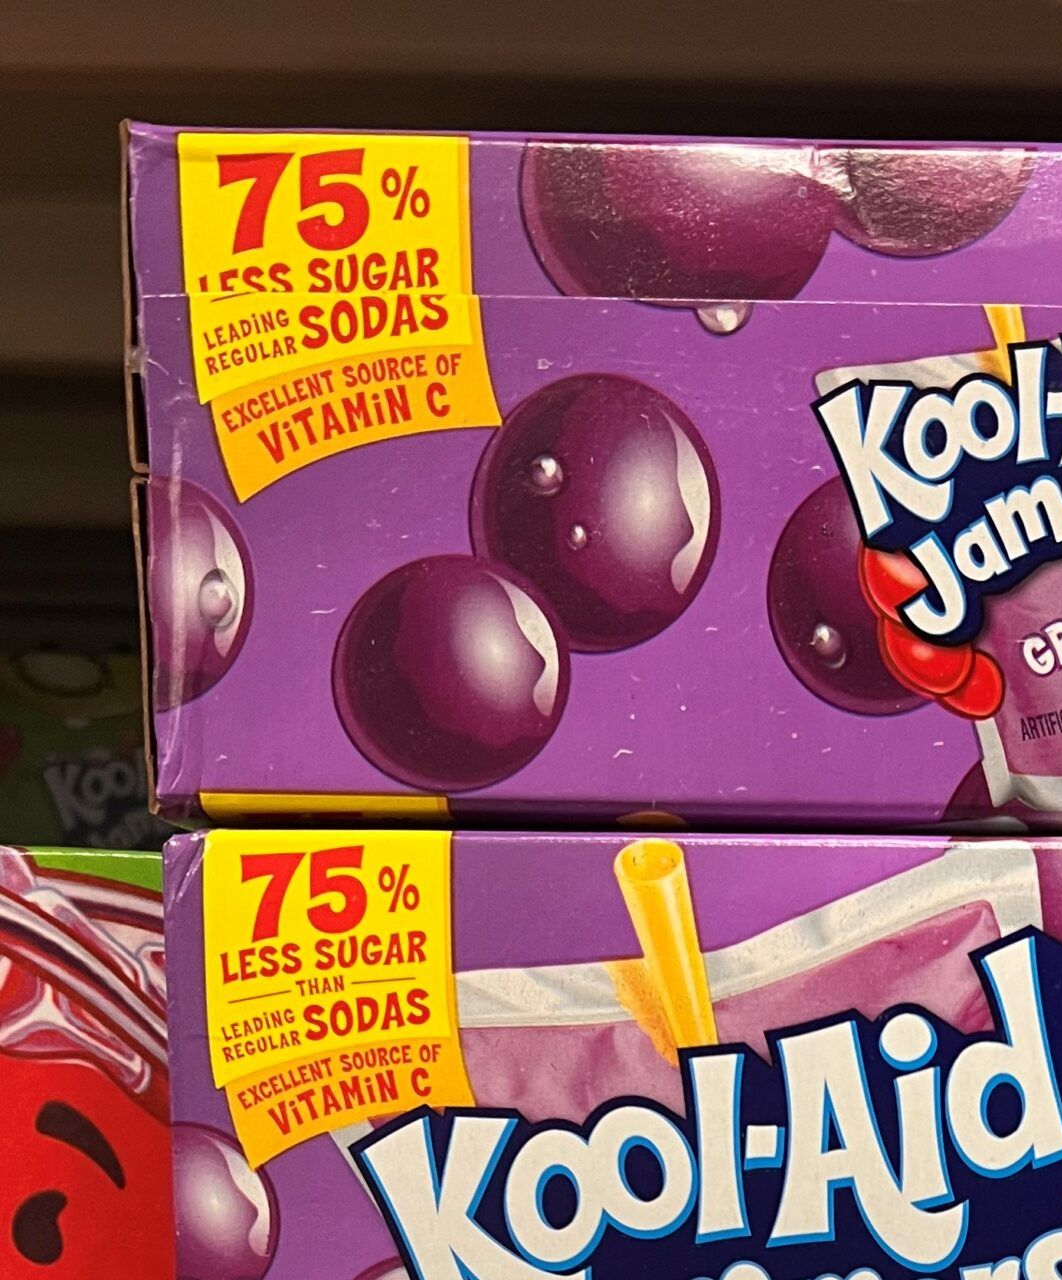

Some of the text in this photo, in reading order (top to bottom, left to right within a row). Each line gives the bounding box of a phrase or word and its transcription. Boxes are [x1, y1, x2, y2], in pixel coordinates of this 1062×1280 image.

[307, 248, 439, 292] SUGAR
[204, 294, 449, 376] REGULAR SODAS
[221, 353, 462, 434] EXCELLENT SOURCE OF
[427, 382, 451, 417] C
[220, 930, 427, 985] LESS SUGAR
[295, 976, 345, 997] THAN
[222, 988, 431, 1064] REGULAR SODAS
[237, 1044, 442, 1110] EXCELLENT SOURCE OF
[411, 1068, 432, 1098] C
